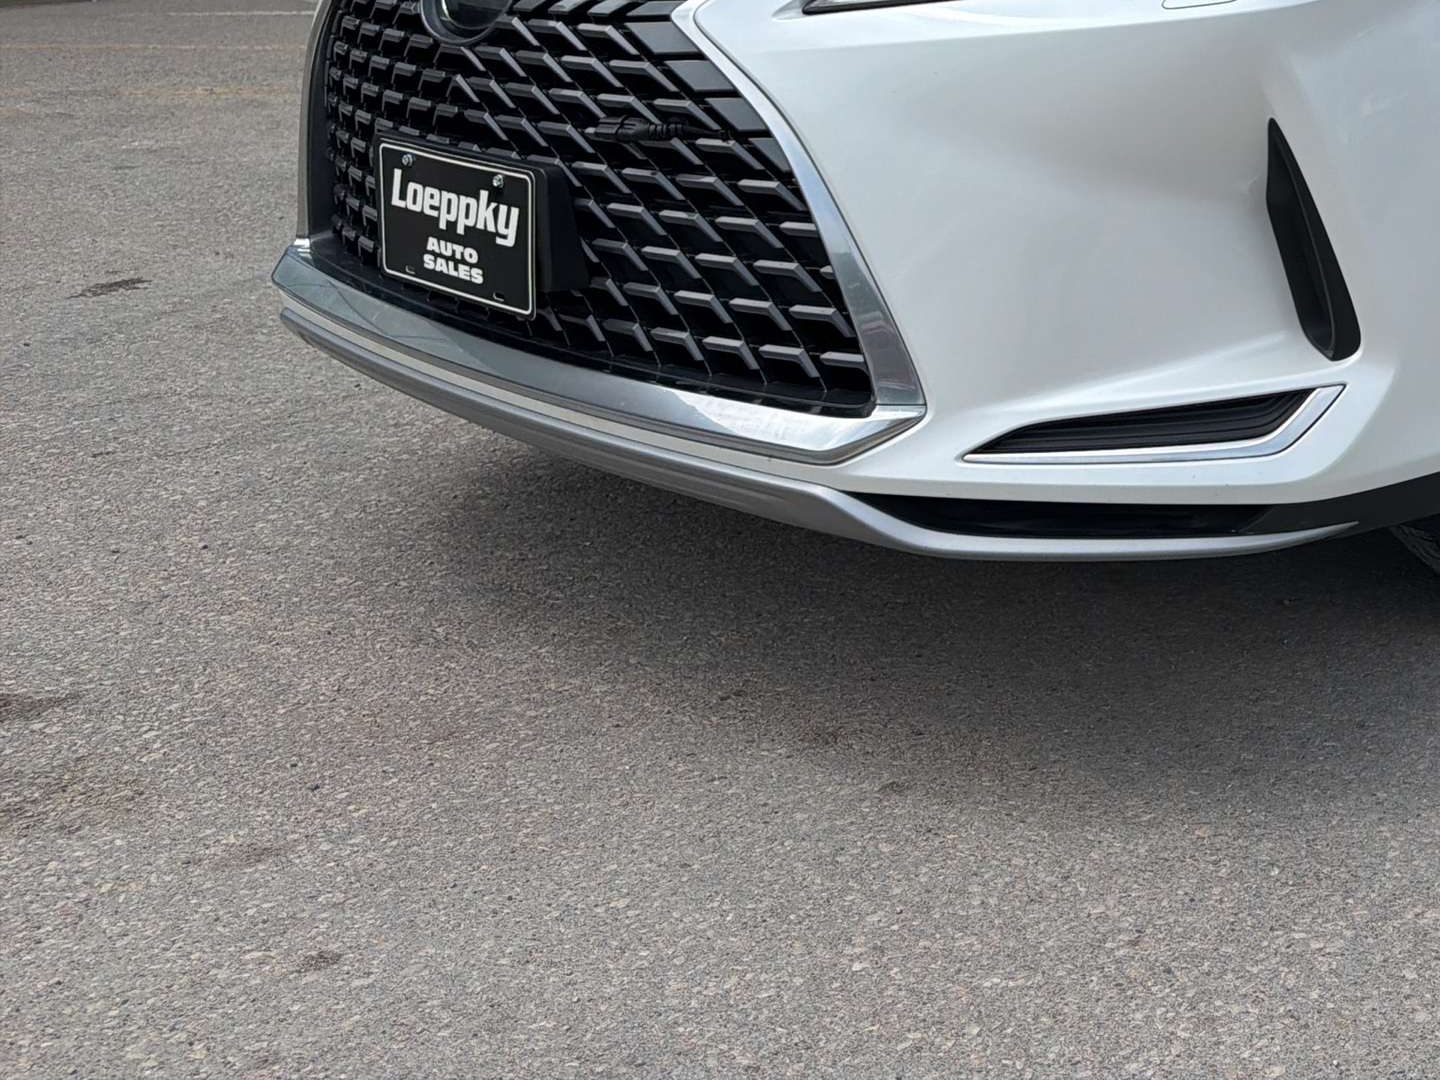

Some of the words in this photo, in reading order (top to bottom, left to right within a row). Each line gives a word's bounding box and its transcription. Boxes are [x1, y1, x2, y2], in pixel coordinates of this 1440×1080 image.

[391, 168, 520, 248] Loeppky
[426, 236, 479, 264] AUTO
[423, 253, 484, 285] SALES
